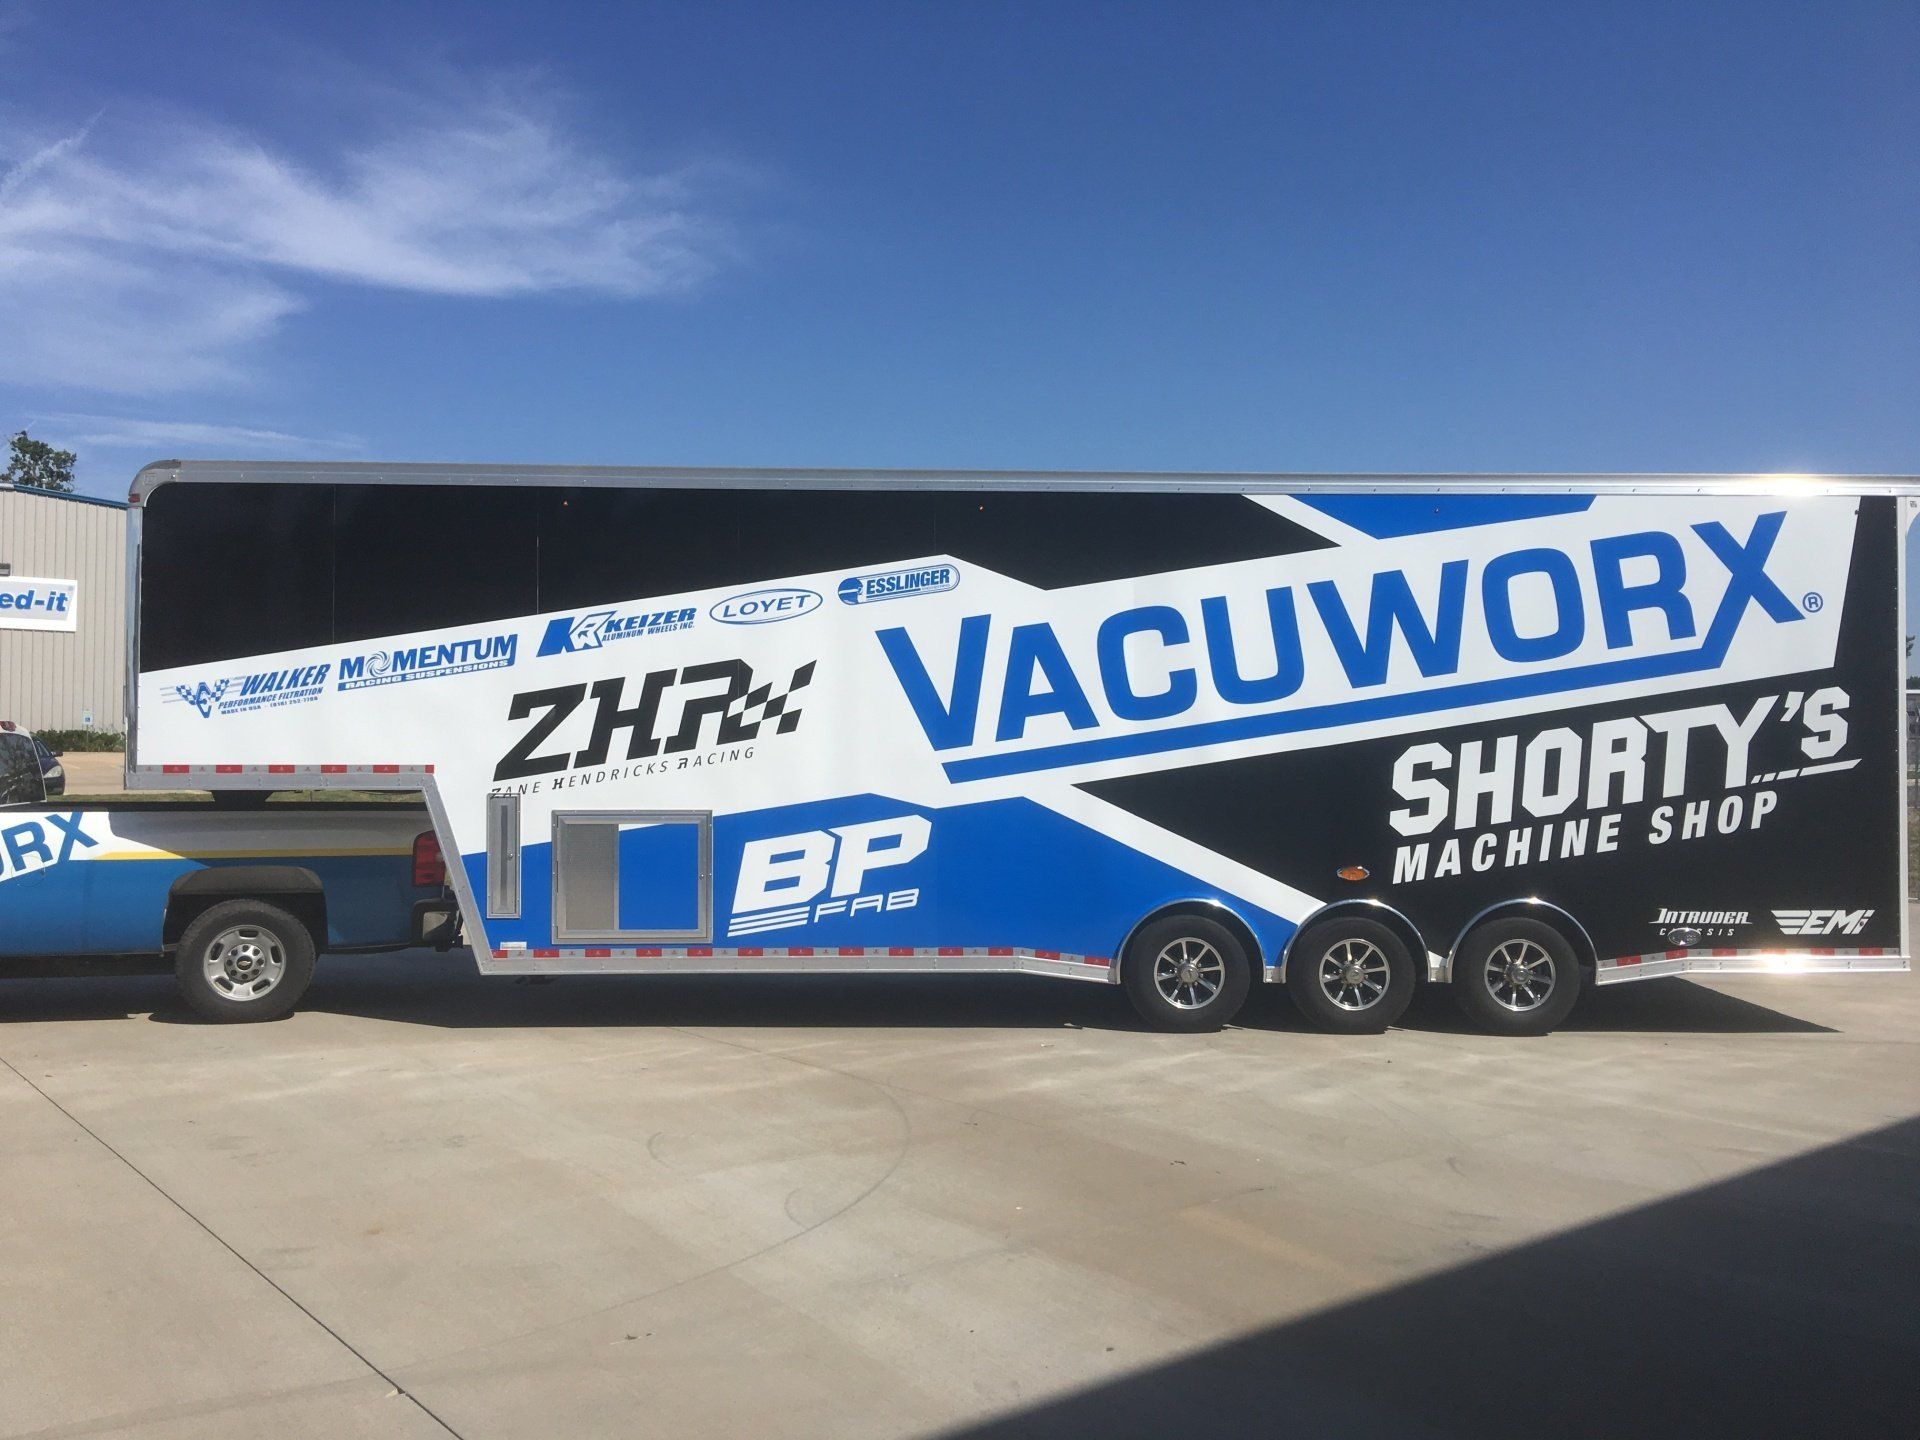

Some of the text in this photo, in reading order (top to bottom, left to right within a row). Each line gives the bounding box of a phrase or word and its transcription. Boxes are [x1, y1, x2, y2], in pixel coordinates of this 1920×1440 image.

[866, 569, 950, 595] ESSLINGER
[604, 607, 697, 633] KEIZER
[723, 595, 811, 617] LOYET
[601, 621, 695, 642] ALUMINUM WHEELS INC.
[339, 634, 518, 680] MOMENTUM
[240, 664, 331, 696] WALKER
[344, 659, 509, 690] RACING SUSPENSIONS
[218, 687, 324, 709] PERFORMANCE FILTRATION
[490, 747, 754, 800] ZANE HENDRICKS RACING
[1389, 686, 1851, 837] SHORTY'S
[0, 811, 100, 876] RX
[1392, 790, 1778, 885] MACHINE SHOP
[732, 814, 932, 914] BP
[814, 888, 919, 923] FAB
[1649, 908, 1753, 924] INTRUDER
[1659, 928, 1735, 937] CSSIS
